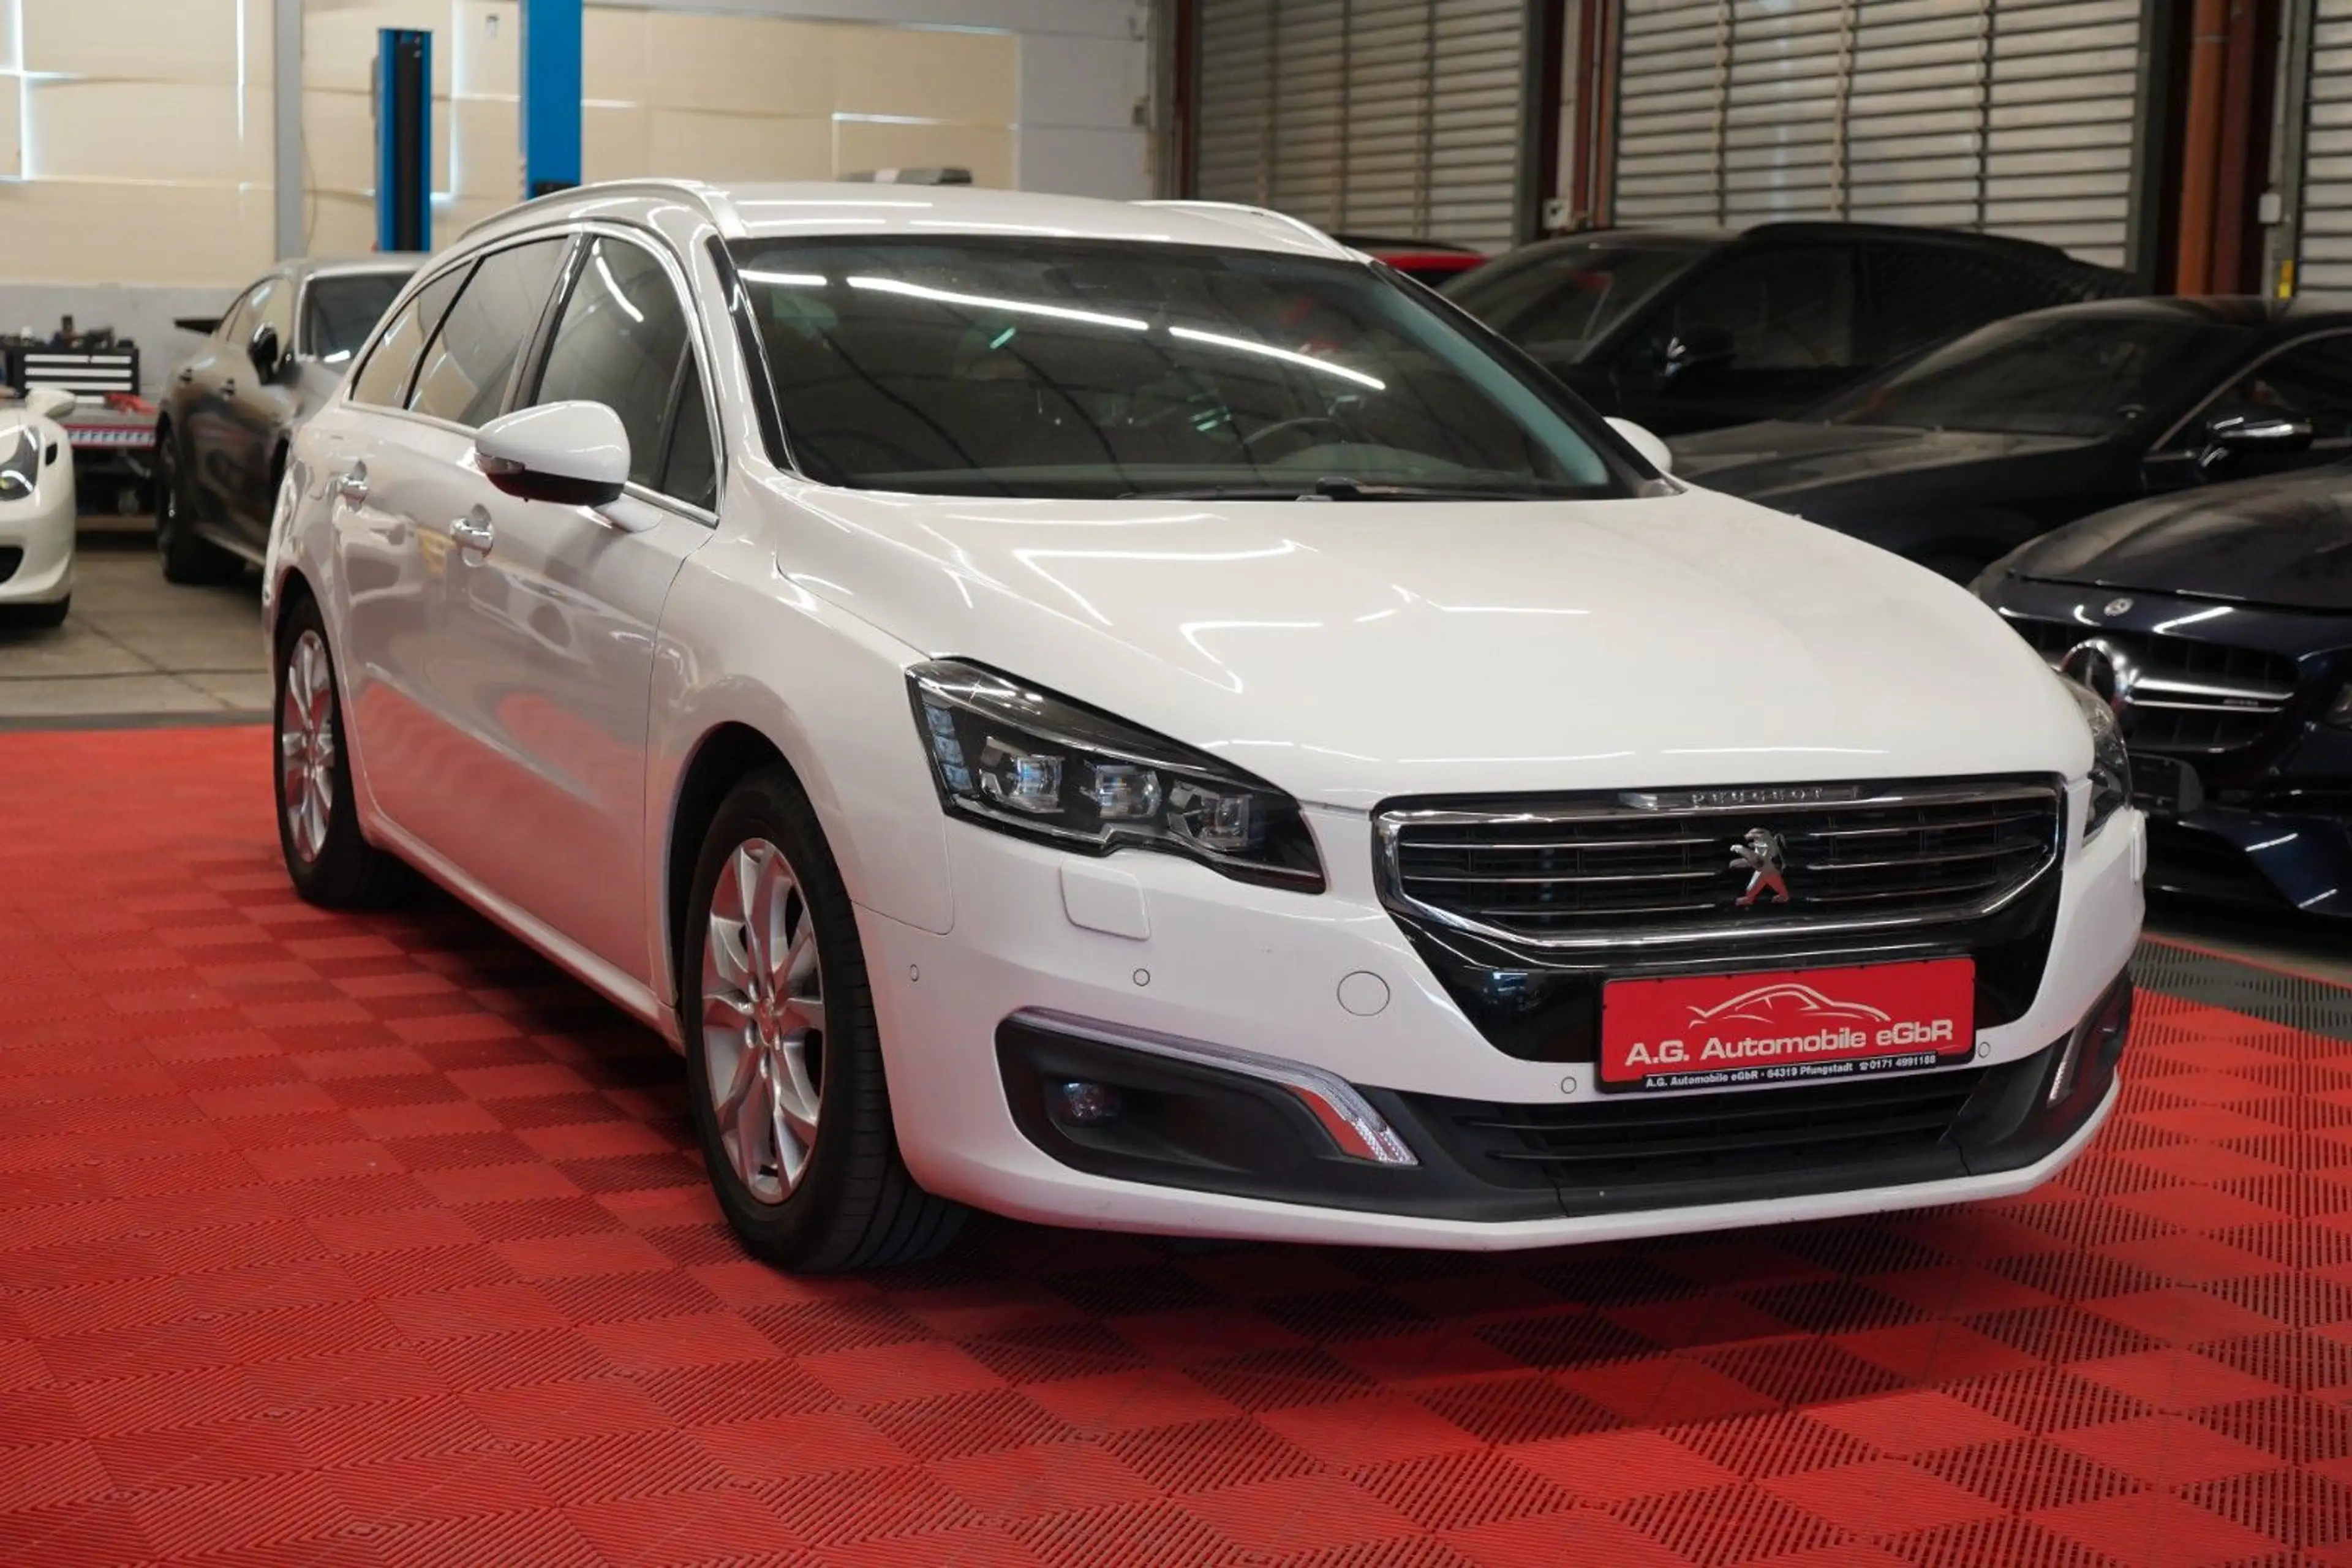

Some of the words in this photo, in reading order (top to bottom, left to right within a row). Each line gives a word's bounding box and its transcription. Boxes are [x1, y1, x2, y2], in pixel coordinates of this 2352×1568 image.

[1625, 1040, 1690, 1066] A.G.
[1700, 1027, 1866, 1060] Automobile
[1875, 1019, 1953, 1046] eGbR
[1646, 1077, 1667, 1088] A.G.
[1670, 1073, 1728, 1087] Automobile
[1731, 1069, 1758, 1081] eGbR
[1800, 1062, 1853, 1076] Pfungstadt
